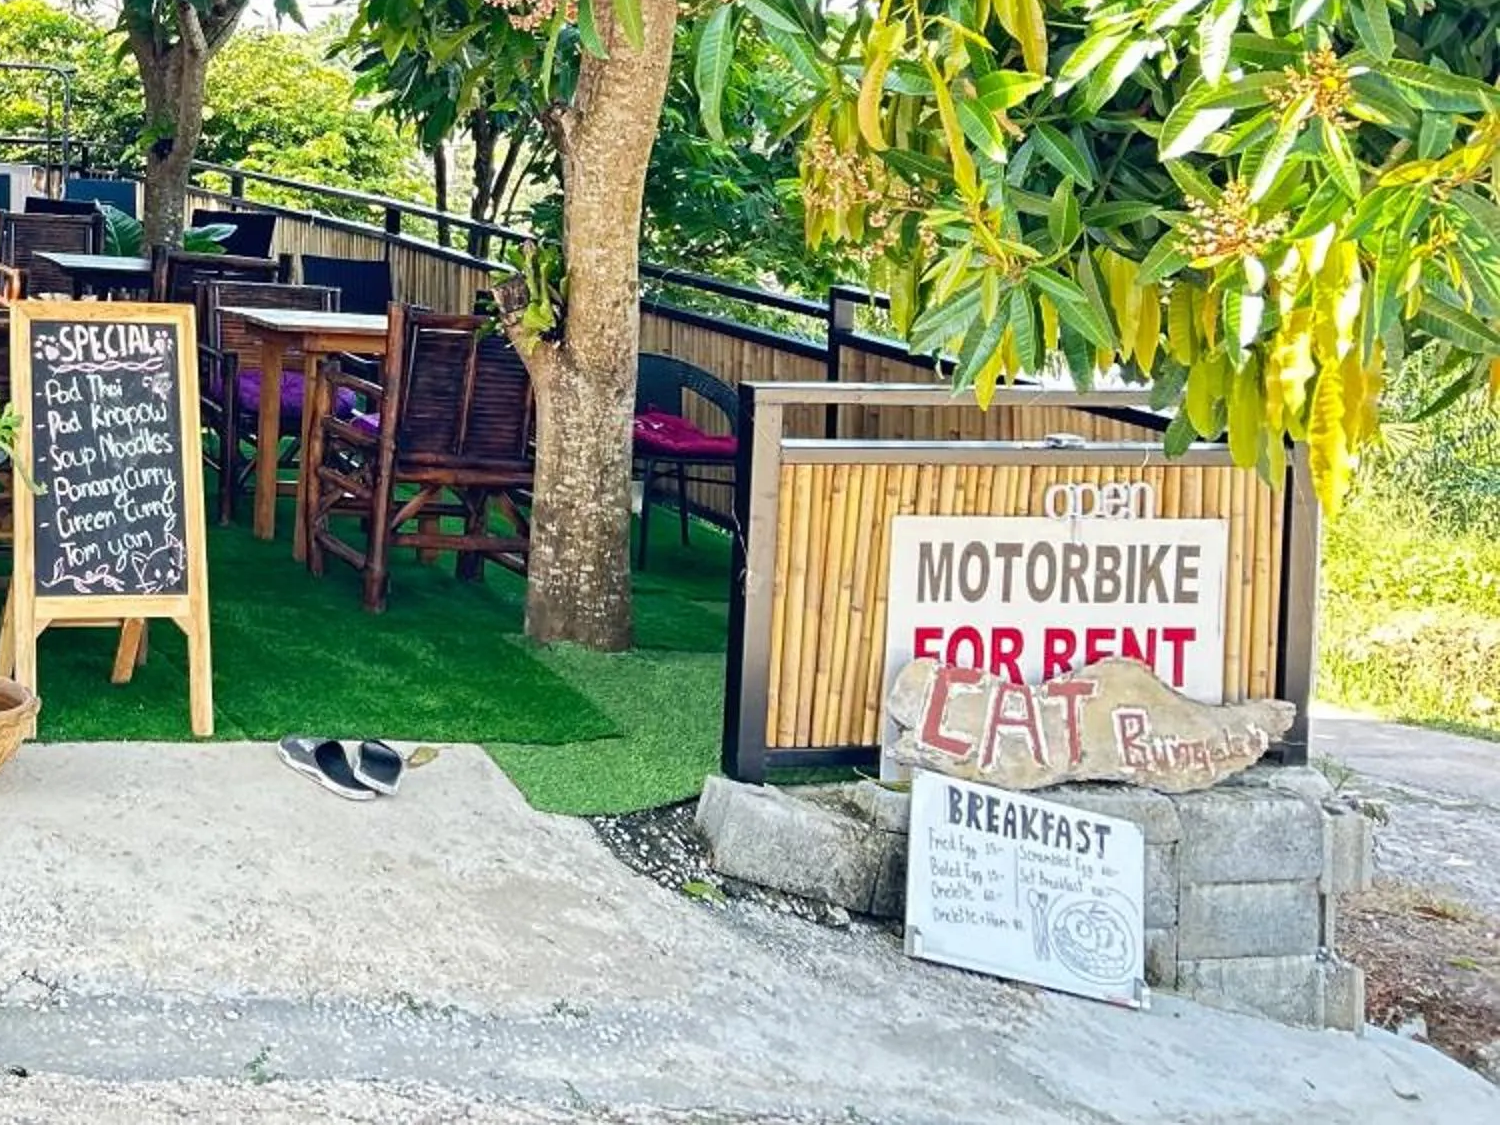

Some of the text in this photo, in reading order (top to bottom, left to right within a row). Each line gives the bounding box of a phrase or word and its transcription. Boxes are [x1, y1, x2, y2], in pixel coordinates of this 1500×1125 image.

[59, 324, 157, 362] SPECIAL
[45, 374, 123, 405] Pad Thai
[47, 410, 82, 444] Pad
[49, 428, 173, 476] Soup Noodles
[124, 467, 176, 504] Curry
[1045, 482, 1155, 520] open
[57, 497, 176, 538] Green Curry
[60, 542, 101, 567] Tom
[917, 541, 1201, 605] MOTORBIKE
[918, 666, 1098, 771] CAT
[948, 785, 1112, 860] BREAKFAST
